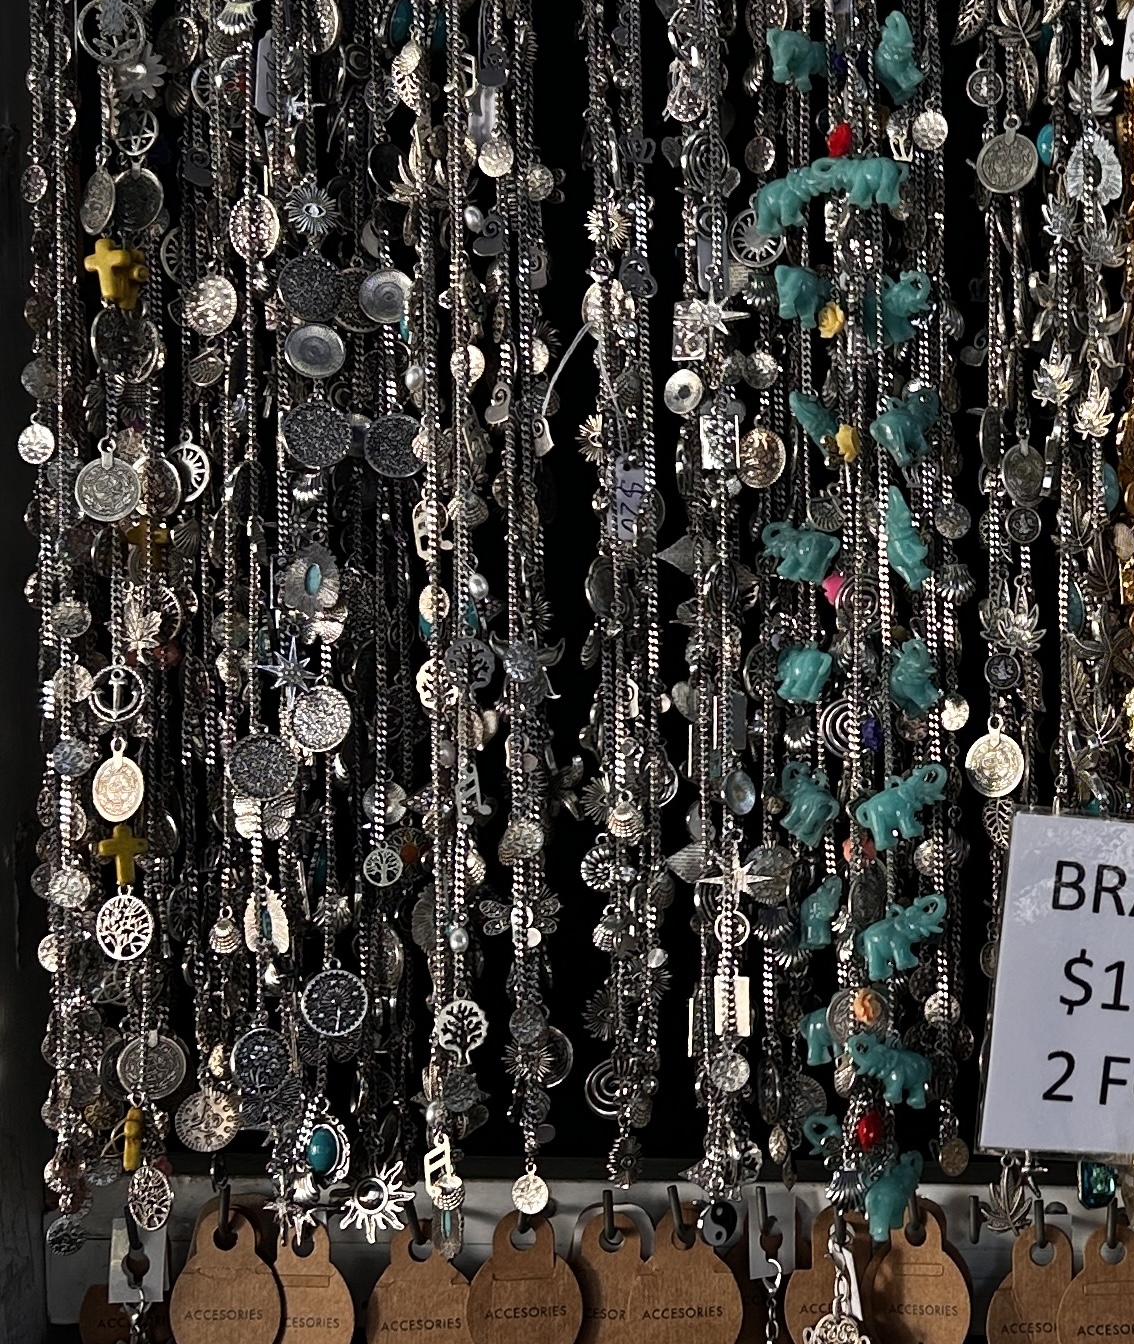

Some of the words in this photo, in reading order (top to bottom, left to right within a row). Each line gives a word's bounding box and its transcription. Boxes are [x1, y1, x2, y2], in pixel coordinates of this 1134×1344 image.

[1042, 1050, 1076, 1103] 2
[184, 1308, 263, 1322] ACCESORIES
[484, 1305, 567, 1321] ACCESORIES
[585, 1307, 626, 1321] CESOR
[642, 1305, 724, 1321] ACCESORIES
[887, 1303, 959, 1317] ACCESORIES
[285, 1316, 341, 1329] CESORIES
[380, 1317, 462, 1332] ACCESORIES
[1001, 1321, 1057, 1334] ACCESO
